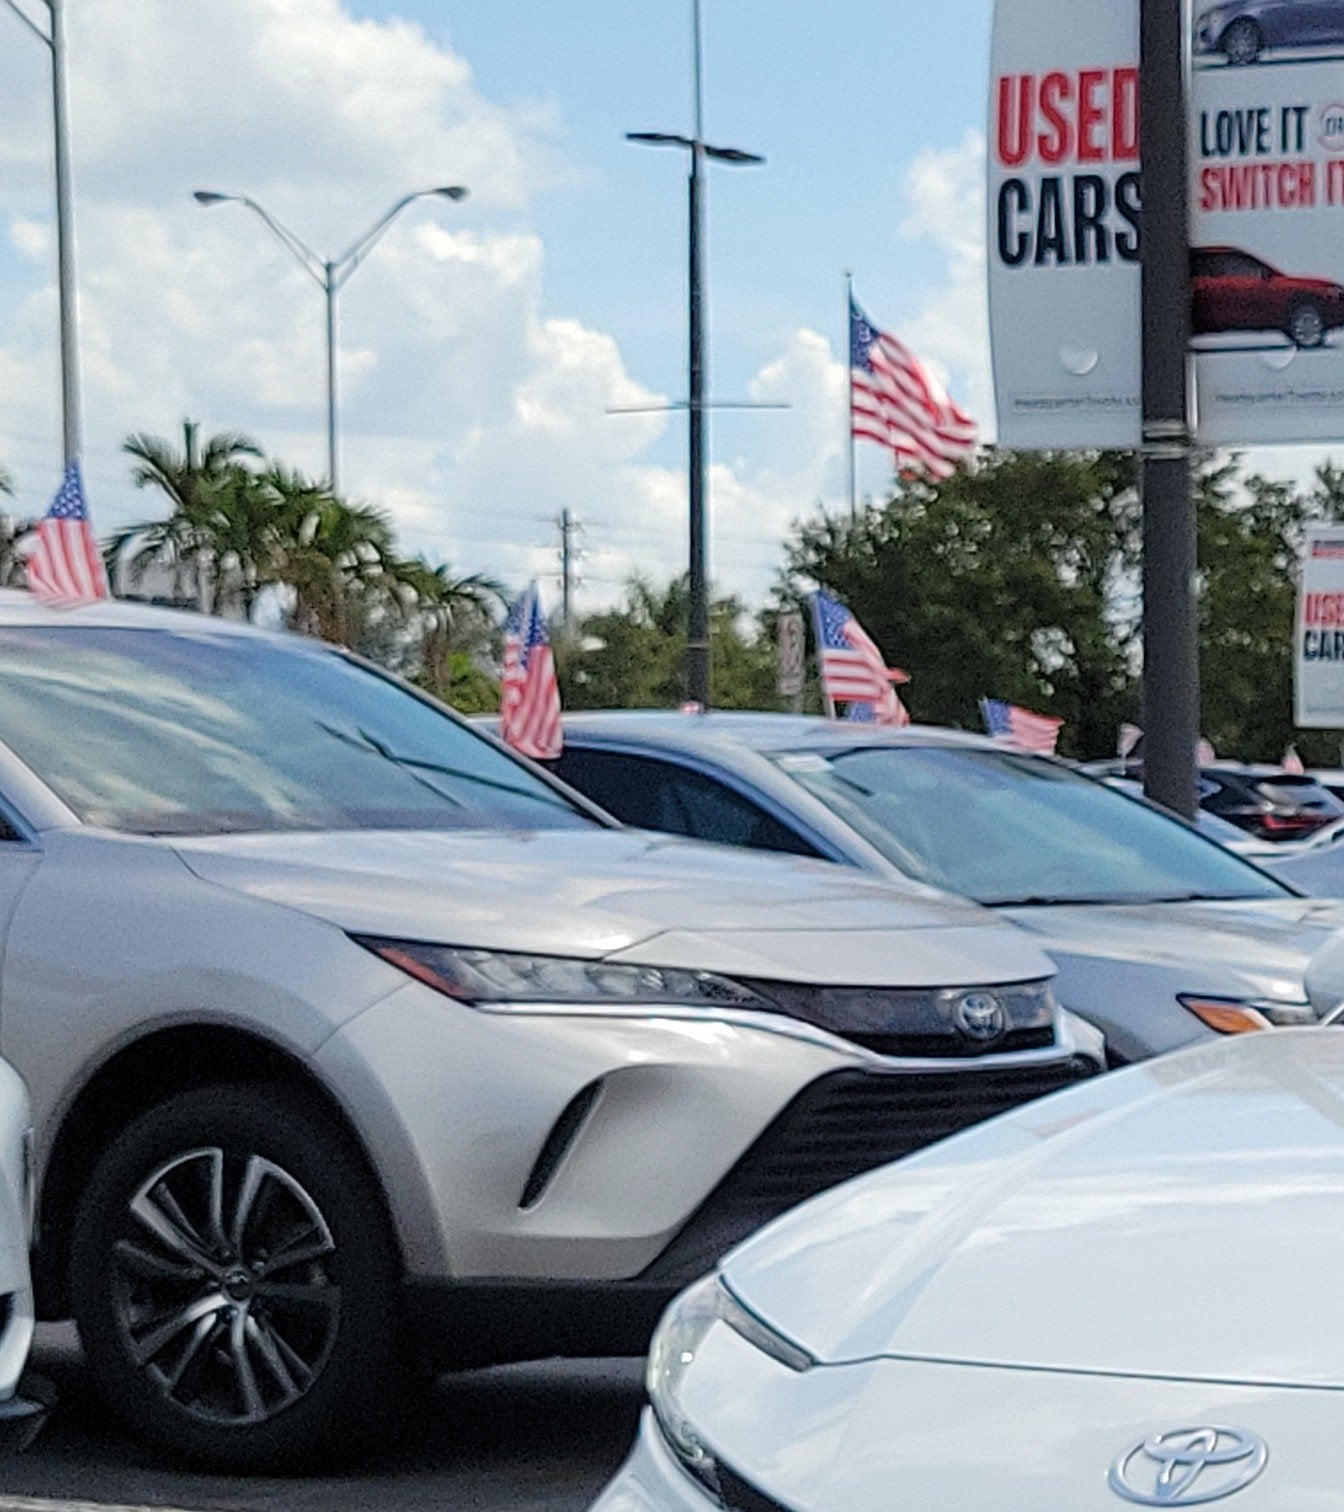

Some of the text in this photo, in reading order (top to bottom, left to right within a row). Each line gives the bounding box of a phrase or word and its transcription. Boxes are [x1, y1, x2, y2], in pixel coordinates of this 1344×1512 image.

[998, 68, 1140, 166] USED
[1200, 106, 1309, 157] LOVE IT
[998, 172, 1141, 265] CARS
[1201, 163, 1316, 210] SWITCH
